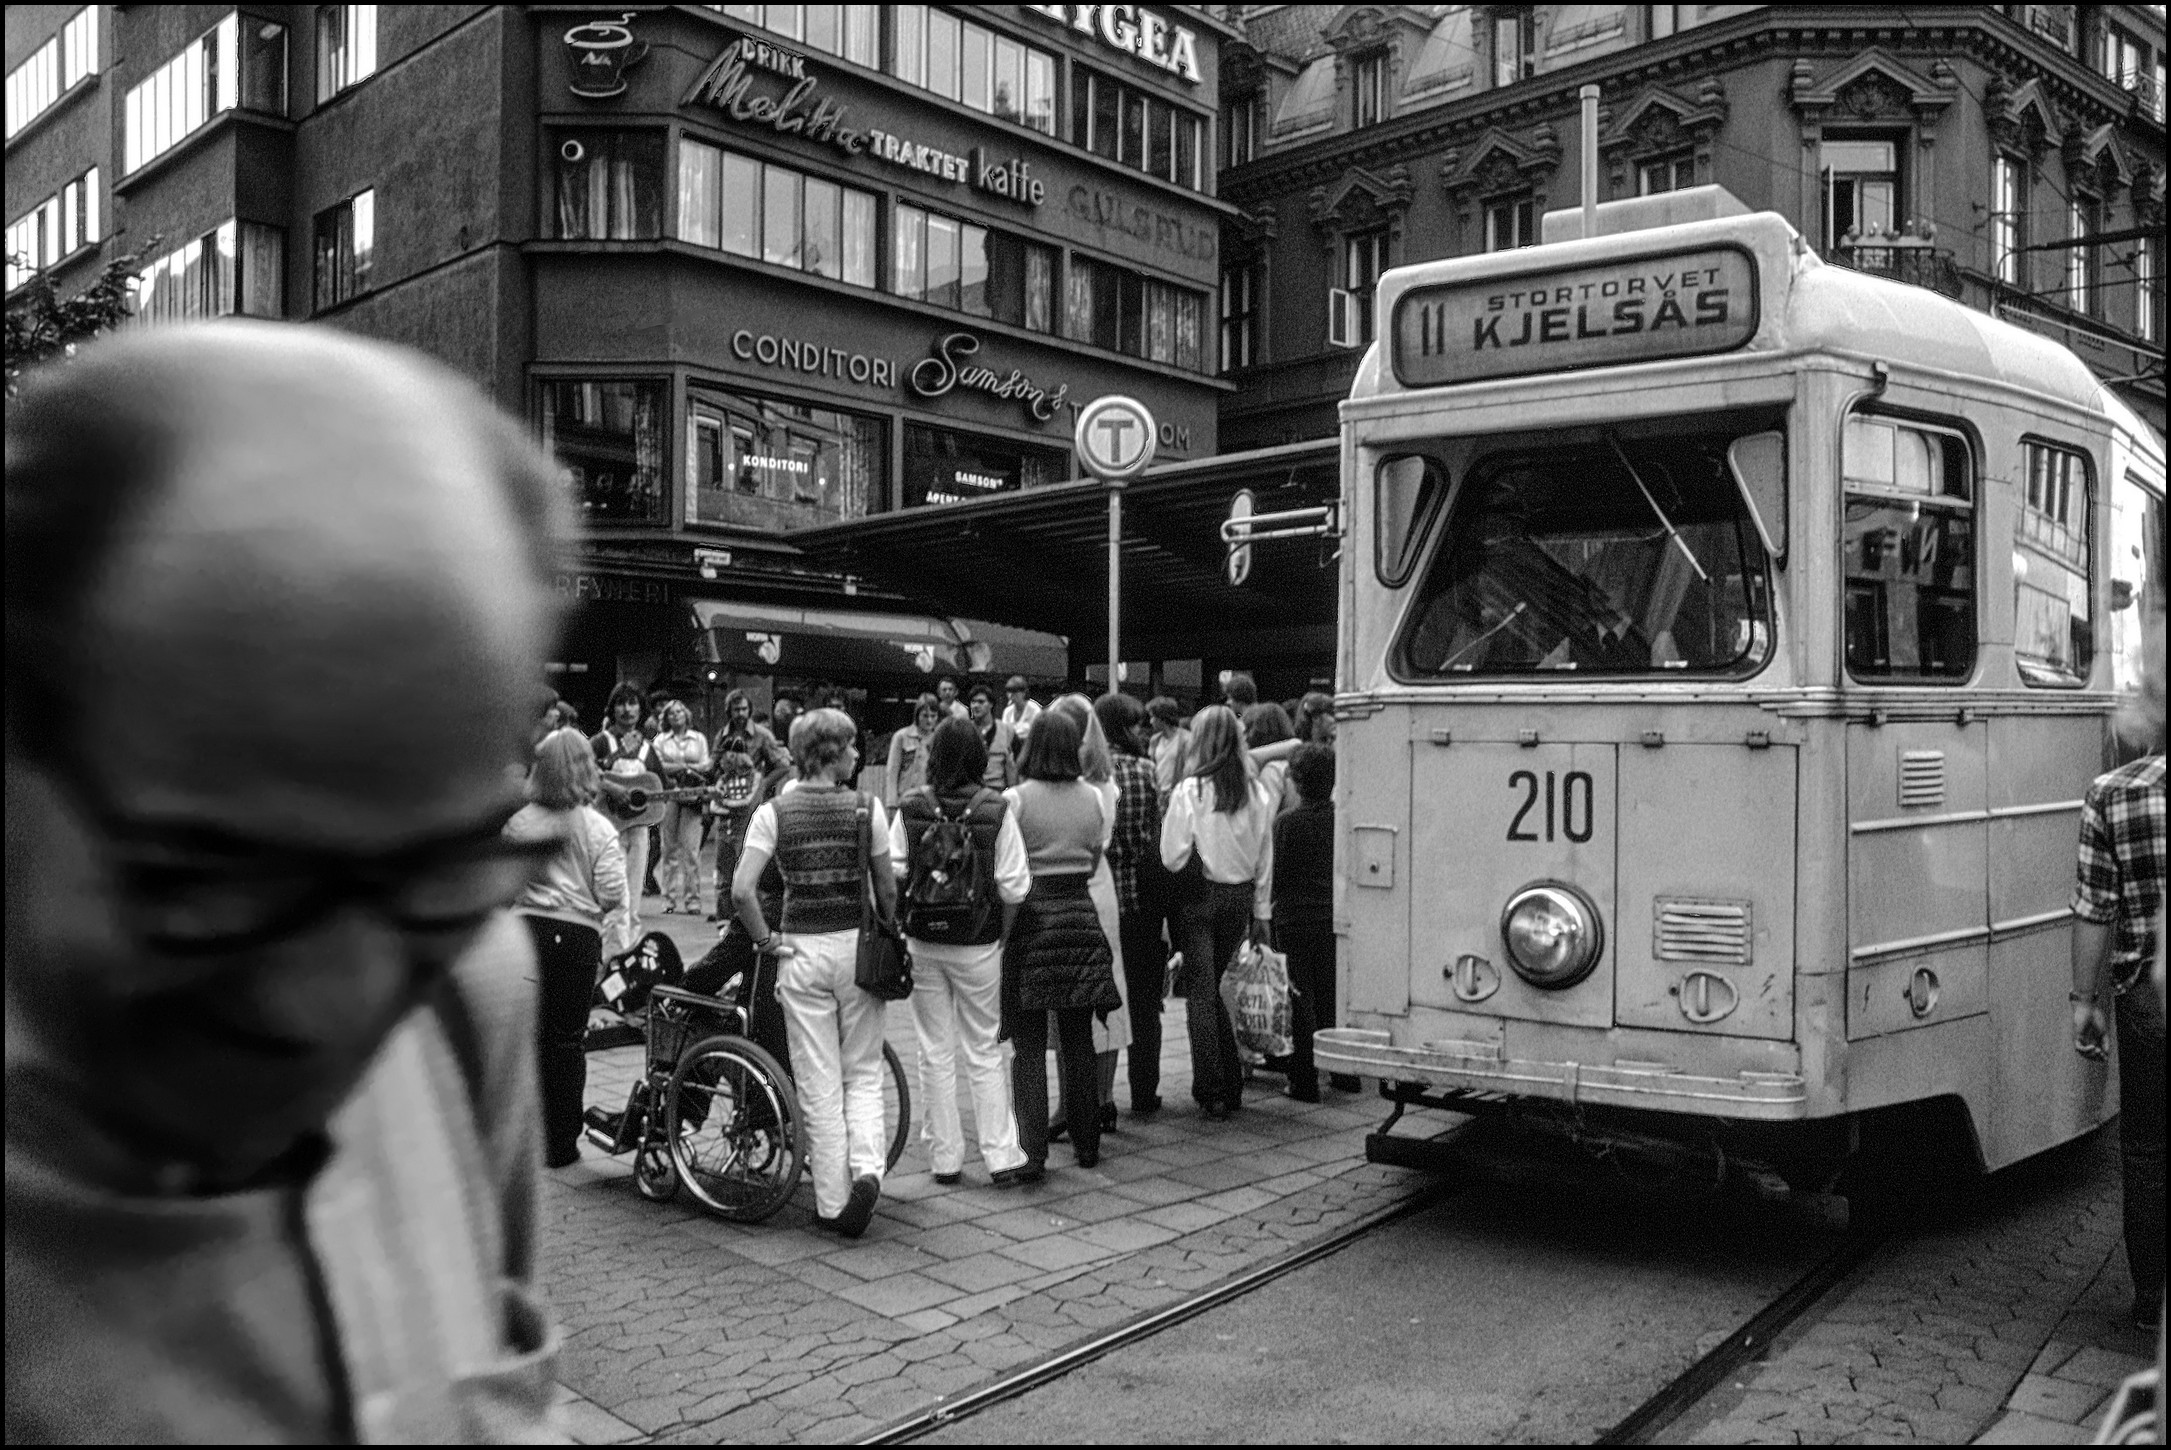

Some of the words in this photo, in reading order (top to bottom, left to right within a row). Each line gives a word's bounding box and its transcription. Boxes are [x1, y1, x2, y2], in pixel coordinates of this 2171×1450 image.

[741, 38, 805, 79] DRIKK
[679, 40, 870, 153] Melitta
[870, 129, 969, 183] TRAKTET
[977, 148, 1045, 206] kaffe
[1487, 267, 1723, 312] STORTORVET
[1421, 302, 1446, 357] 11
[1473, 288, 1730, 351] KJELSÅS
[733, 329, 896, 388] CONDITORI
[742, 454, 809, 474] KONDITORI
[1096, 419, 1134, 463] T
[1506, 770, 1594, 843] 210
